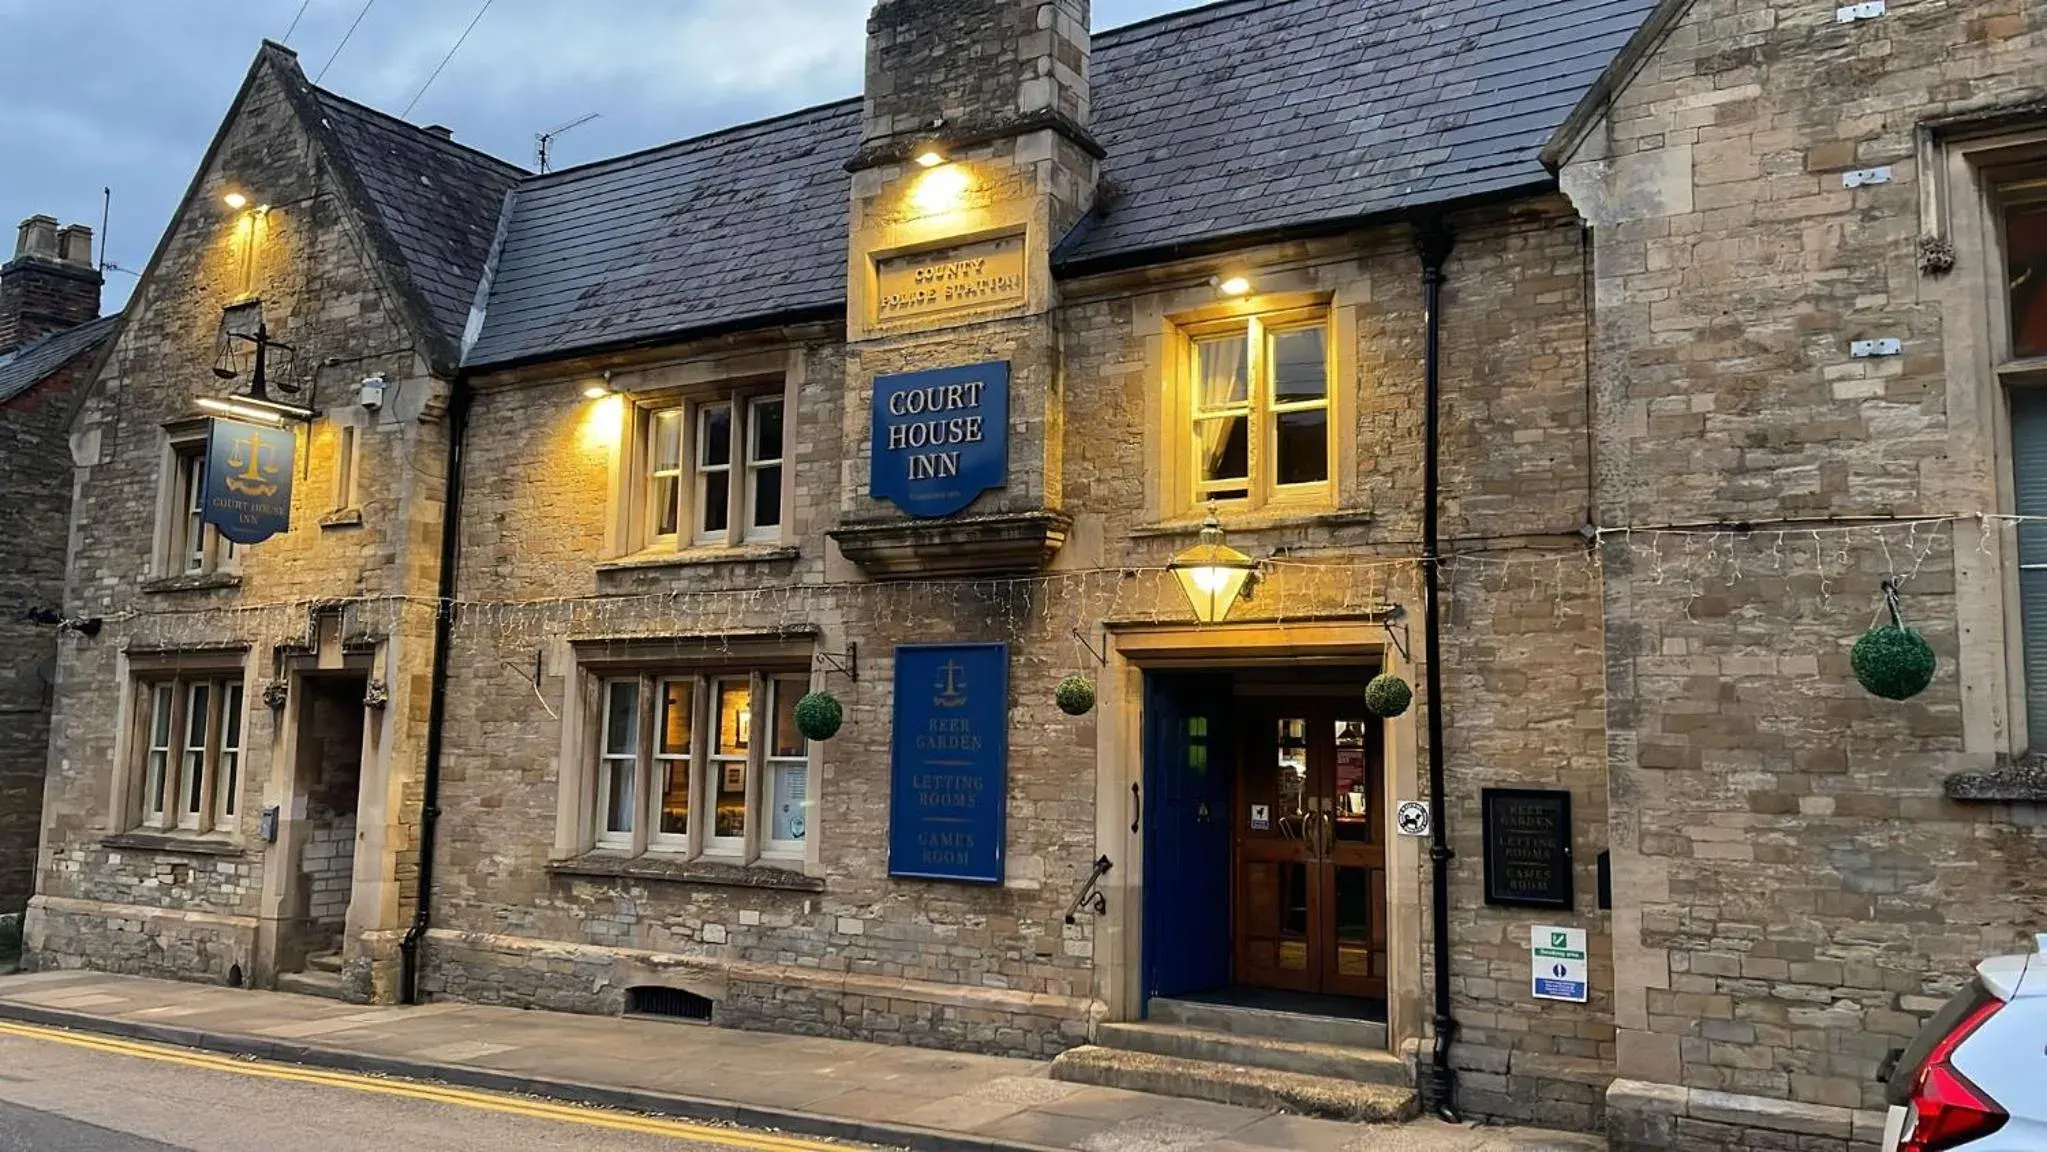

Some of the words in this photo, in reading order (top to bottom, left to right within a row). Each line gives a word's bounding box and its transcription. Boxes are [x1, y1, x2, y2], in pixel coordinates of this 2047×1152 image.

[915, 257, 985, 283] COUNTY
[880, 289, 937, 309] POLICE
[945, 274, 1022, 300] STATION
[889, 382, 984, 416] COURT
[888, 416, 983, 450] HOUSE
[907, 451, 960, 480] INN
[213, 499, 248, 511] COURT
[240, 514, 258, 525] INN
[929, 717, 970, 732] BEER
[915, 734, 982, 752] GARDEN
[913, 774, 984, 791] LETTING
[919, 792, 976, 808] ROOMS
[922, 849, 969, 866] ROOM
